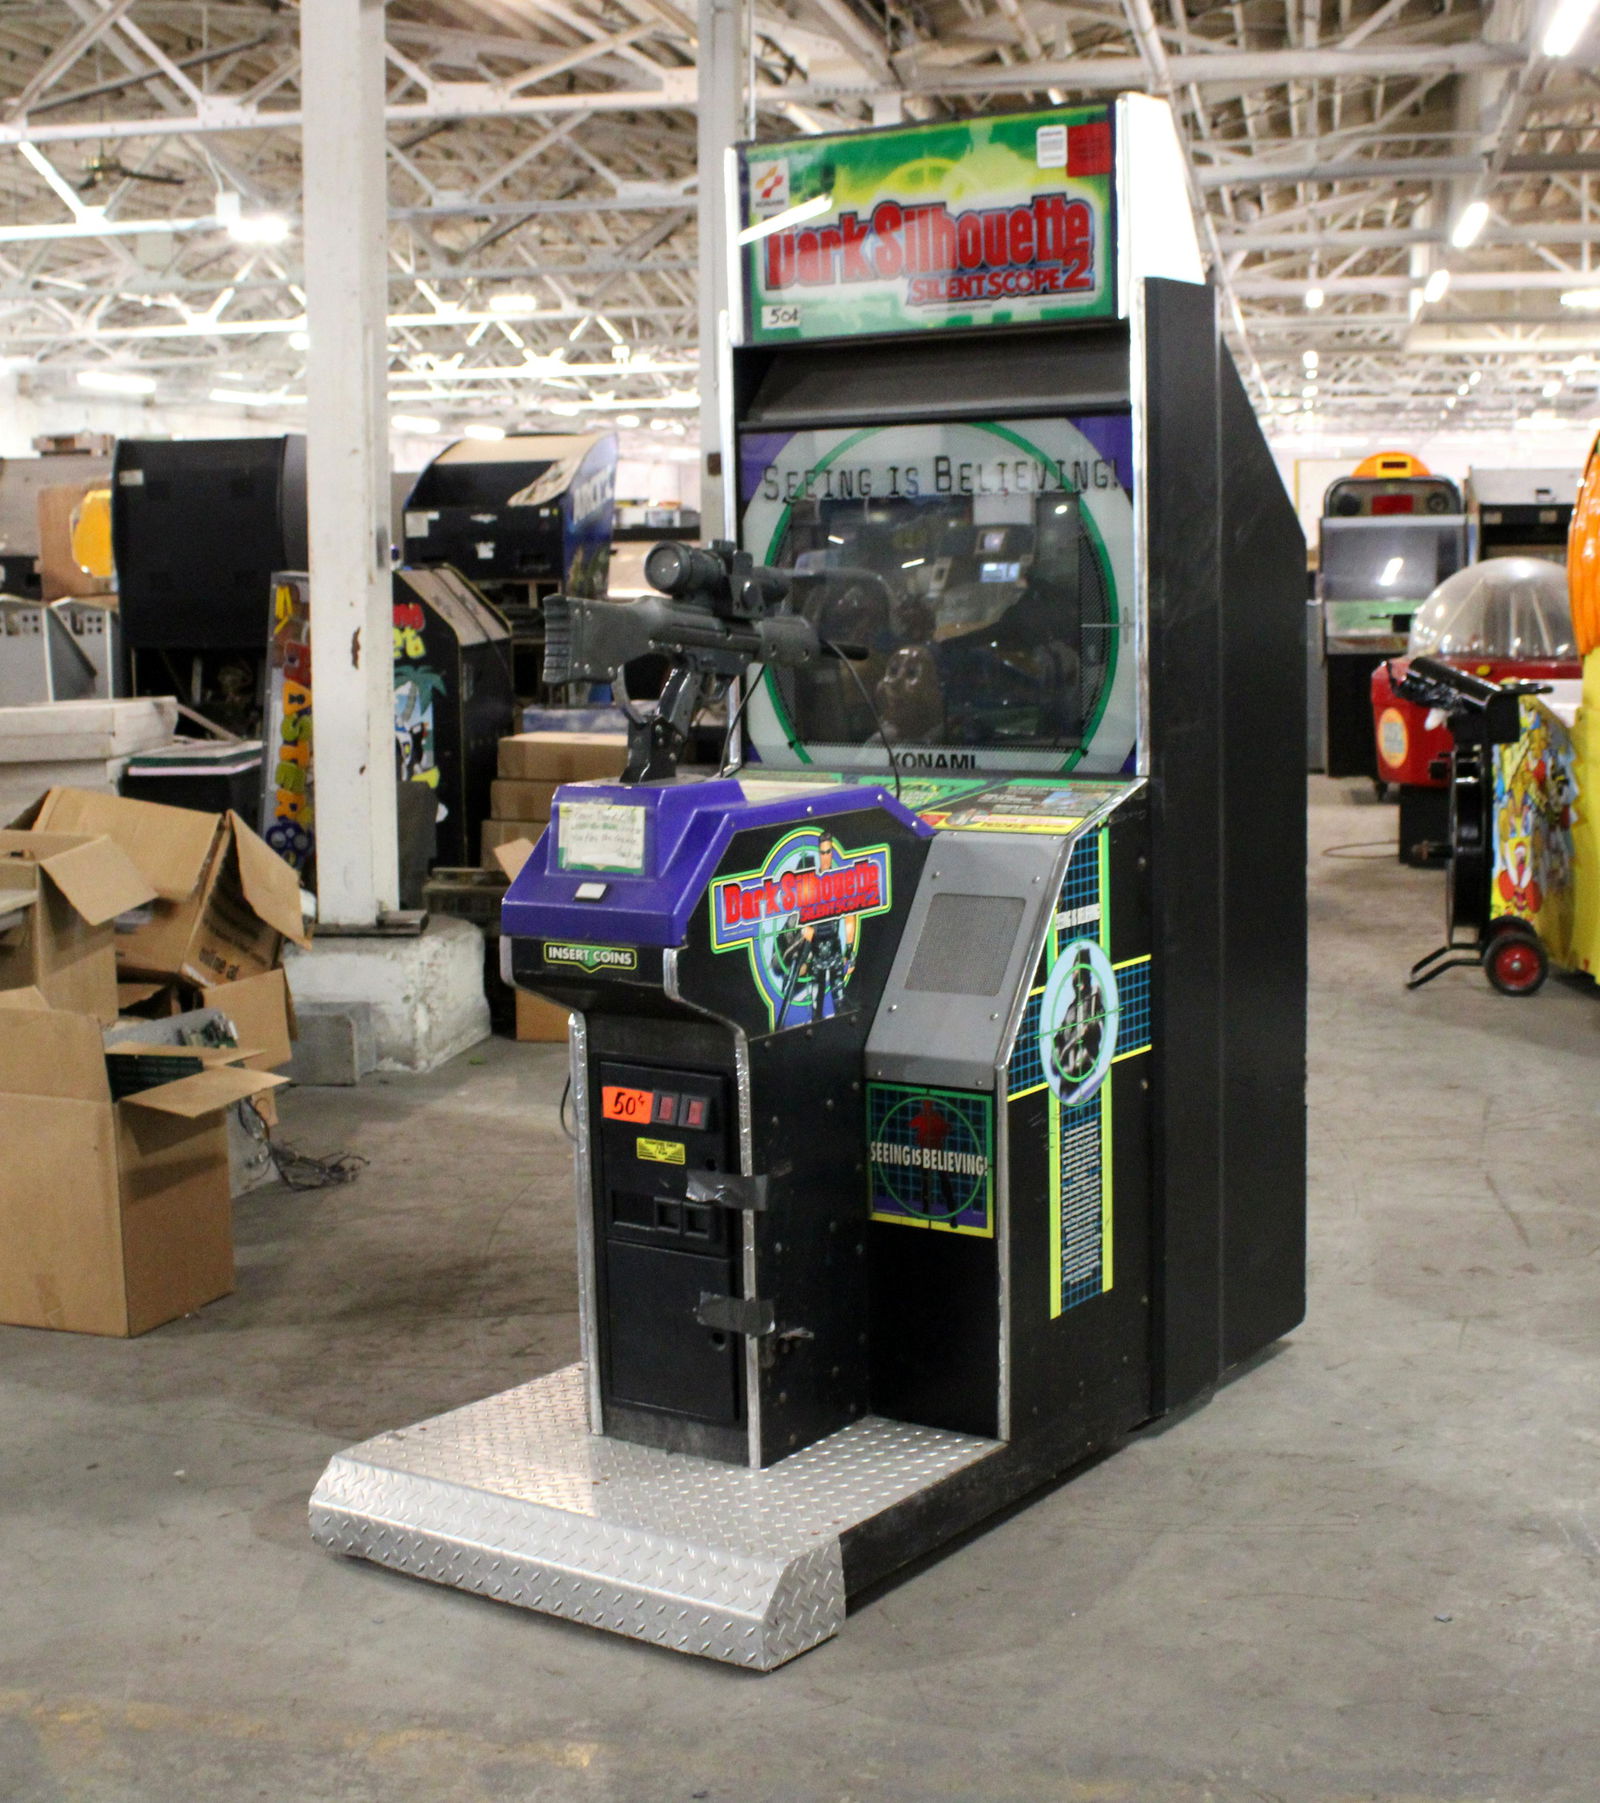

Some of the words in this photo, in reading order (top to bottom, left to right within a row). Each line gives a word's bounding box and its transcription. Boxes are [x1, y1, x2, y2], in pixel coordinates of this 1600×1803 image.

[764, 211, 871, 290] Dark
[873, 194, 1092, 278] Silhouette
[911, 274, 986, 302] SILENT
[987, 267, 1062, 297] SCOPE
[1063, 247, 1091, 289] 2
[723, 878, 781, 925] Dark
[780, 860, 880, 912] Silhouette
[548, 946, 589, 961] INSERT
[593, 950, 632, 966] COINS
[870, 1141, 911, 1166] SEEING
[911, 1148, 922, 1166] IS
[922, 1147, 989, 1177] BELIEVING!
